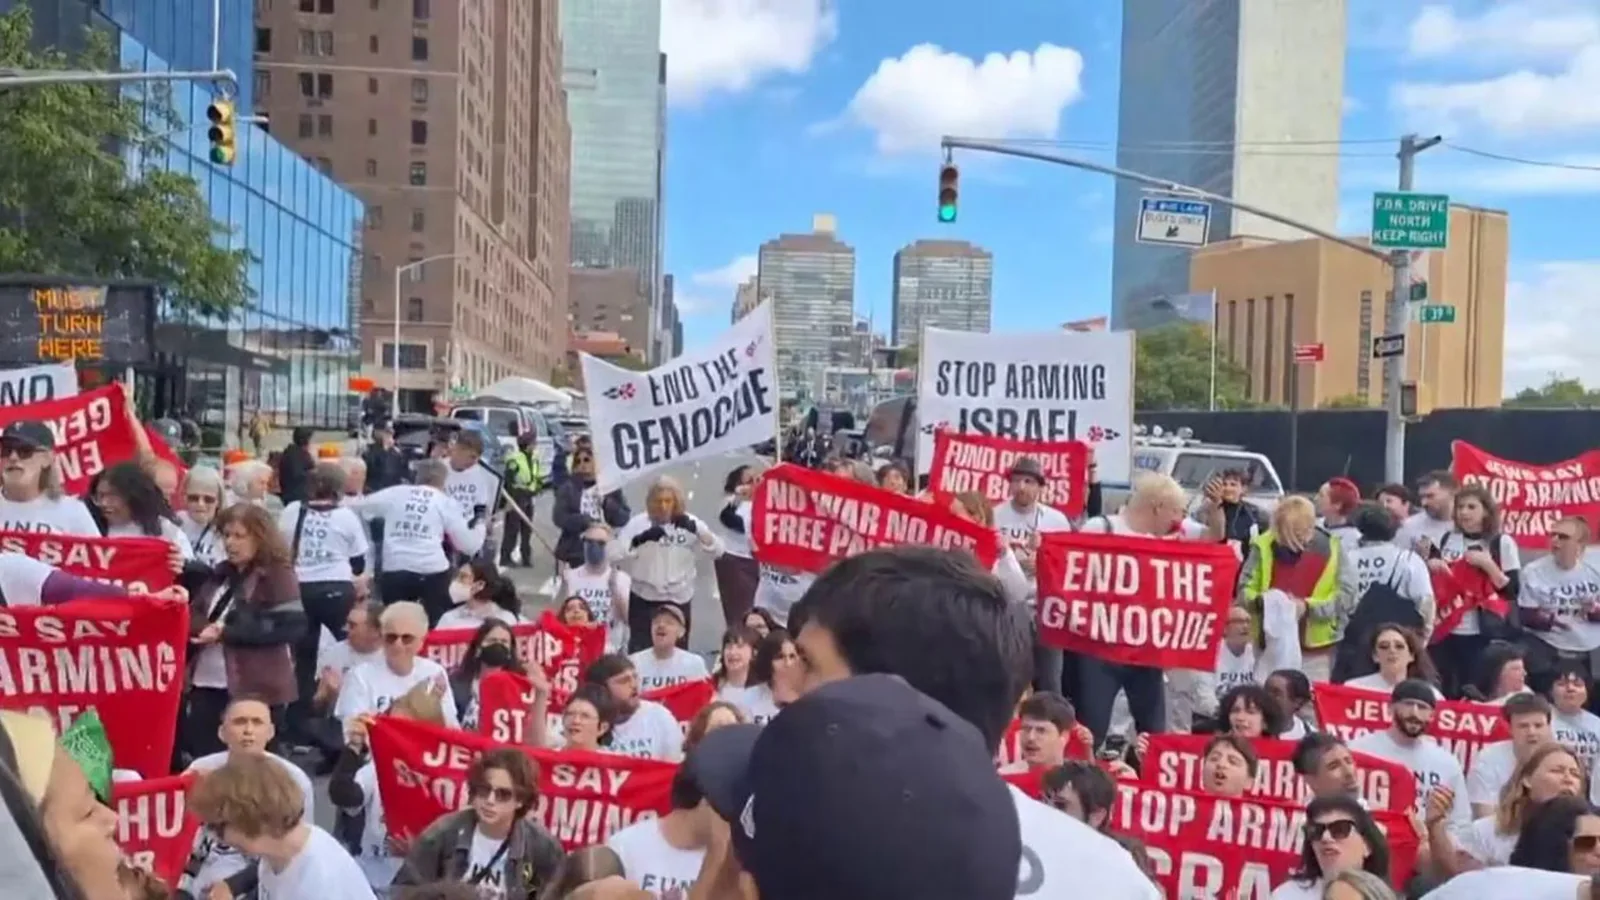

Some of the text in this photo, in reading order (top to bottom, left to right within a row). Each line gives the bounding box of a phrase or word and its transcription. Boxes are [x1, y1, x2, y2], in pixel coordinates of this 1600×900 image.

[1389, 214, 1431, 228] NORTH
[1408, 200, 1446, 213] DRIVE
[1374, 229, 1444, 243] KEEP RIGHT
[39, 314, 104, 333] TURN
[38, 338, 104, 358] HERE
[1, 374, 54, 406] ND
[648, 347, 738, 407] END THE
[936, 360, 1106, 400] STOP ARMING
[611, 368, 772, 470] GENOCIDE
[944, 440, 997, 472] FUND
[940, 466, 985, 493] NOT
[766, 479, 807, 510] NO
[811, 490, 880, 536] WAR
[884, 509, 929, 544] NO
[764, 513, 826, 551] FREE
[38, 540, 118, 570] SAY
[1358, 556, 1385, 569] NO
[1063, 551, 1213, 604] END THE
[34, 615, 131, 643] SAY
[1041, 596, 1217, 651] GENOCIDE
[642, 676, 688, 688] FUND
[1438, 709, 1498, 736] SAY
[551, 764, 631, 797] SAY
[1115, 785, 1307, 855] TOP ARM
[642, 873, 696, 891] FUN
